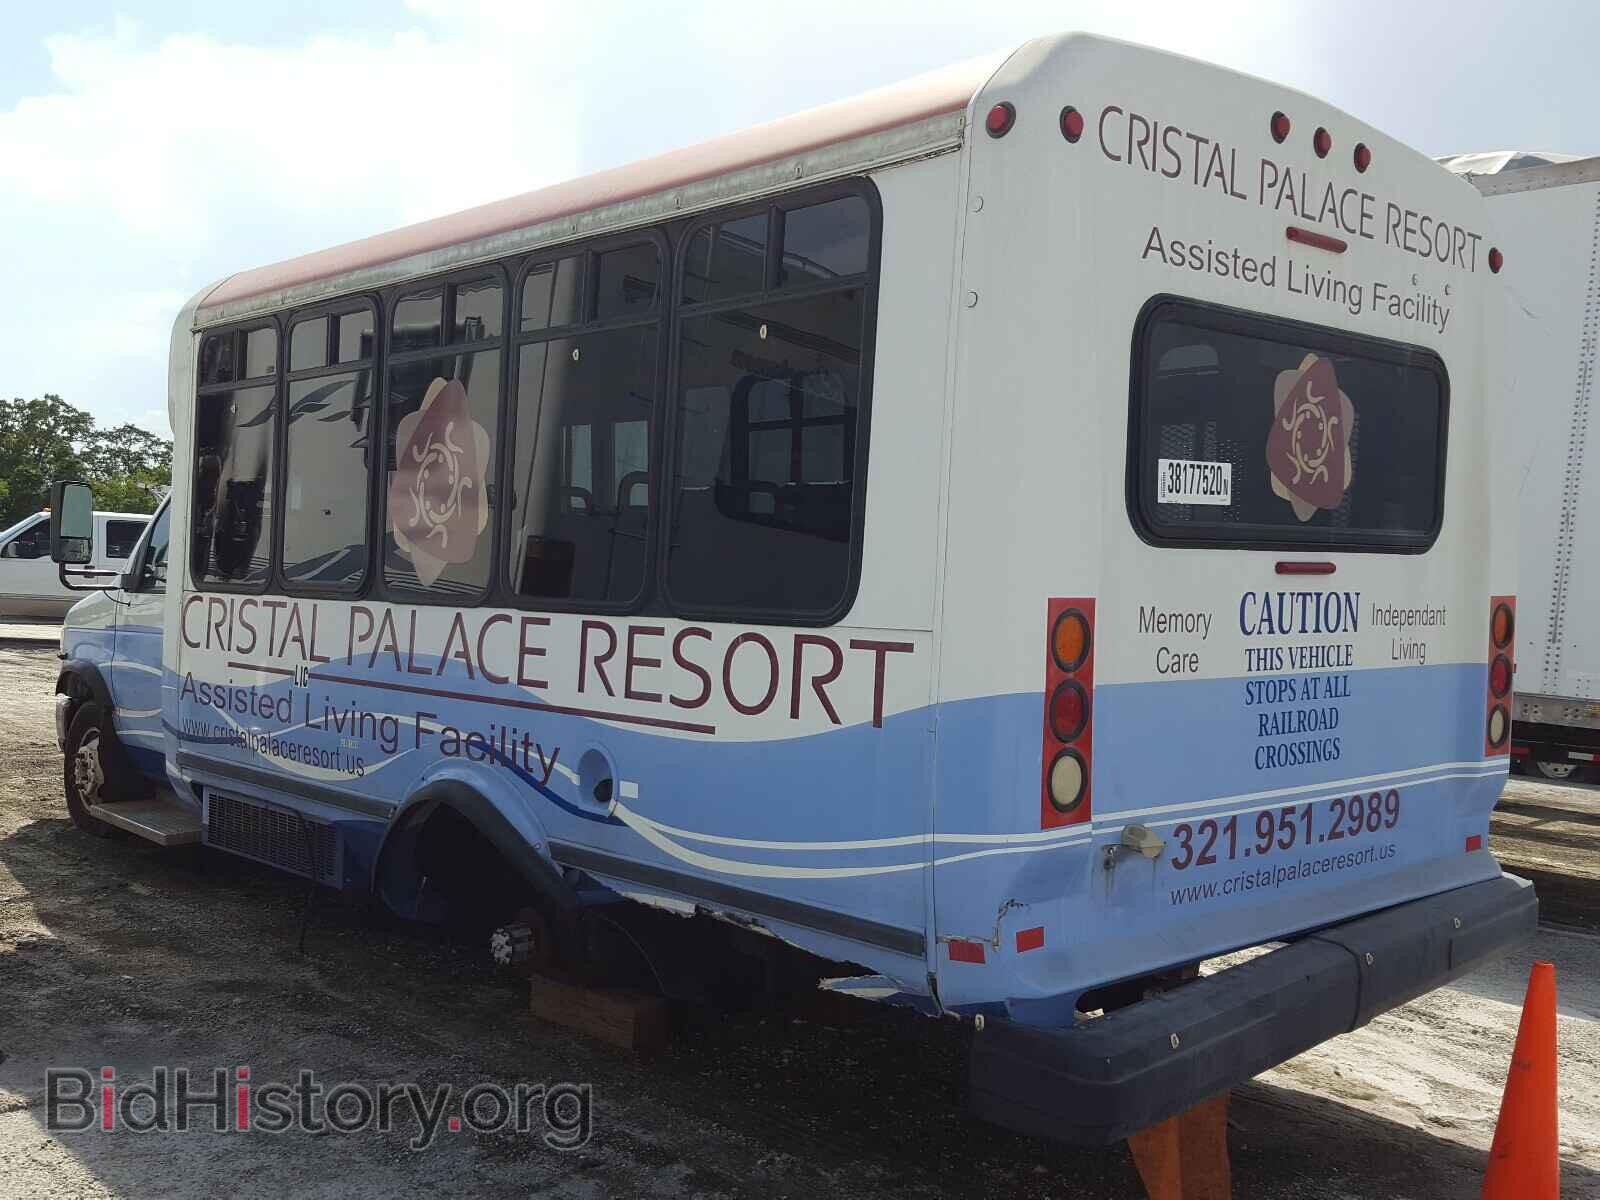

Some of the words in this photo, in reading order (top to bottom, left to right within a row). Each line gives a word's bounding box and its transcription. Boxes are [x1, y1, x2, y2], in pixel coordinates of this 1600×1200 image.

[1098, 105, 1248, 200] CRISTAL
[1260, 159, 1376, 239] PALACE
[1386, 202, 1482, 272] RESORT
[1142, 226, 1276, 287] Assisted
[1288, 260, 1363, 315] Living
[1372, 282, 1450, 333] Facility
[1138, 606, 1212, 640] Memory
[1239, 591, 1361, 636] CAUTION
[1371, 602, 1447, 627] Independant
[181, 595, 331, 663] CRISTAL
[347, 606, 551, 689] PALACE
[577, 620, 915, 728] RESORT
[1156, 646, 1199, 674] Care
[1245, 648, 1283, 672] THIS
[1288, 644, 1353, 670] VEHICLE
[1391, 638, 1426, 664] Living
[1245, 678, 1296, 705] STOPS
[1300, 676, 1321, 700] AT
[1324, 675, 1351, 698] ALL
[180, 671, 293, 724] Assisted
[305, 692, 399, 754] Living
[415, 711, 561, 787] Facility
[1258, 707, 1339, 737] RAILROAD
[182, 717, 365, 777] www.cristalpalaceresort.us
[1255, 737, 1341, 770] CROSSINGS
[1171, 788, 1400, 870] 321.951.2989
[1170, 843, 1397, 905] www.cristalpalaceresort.us
